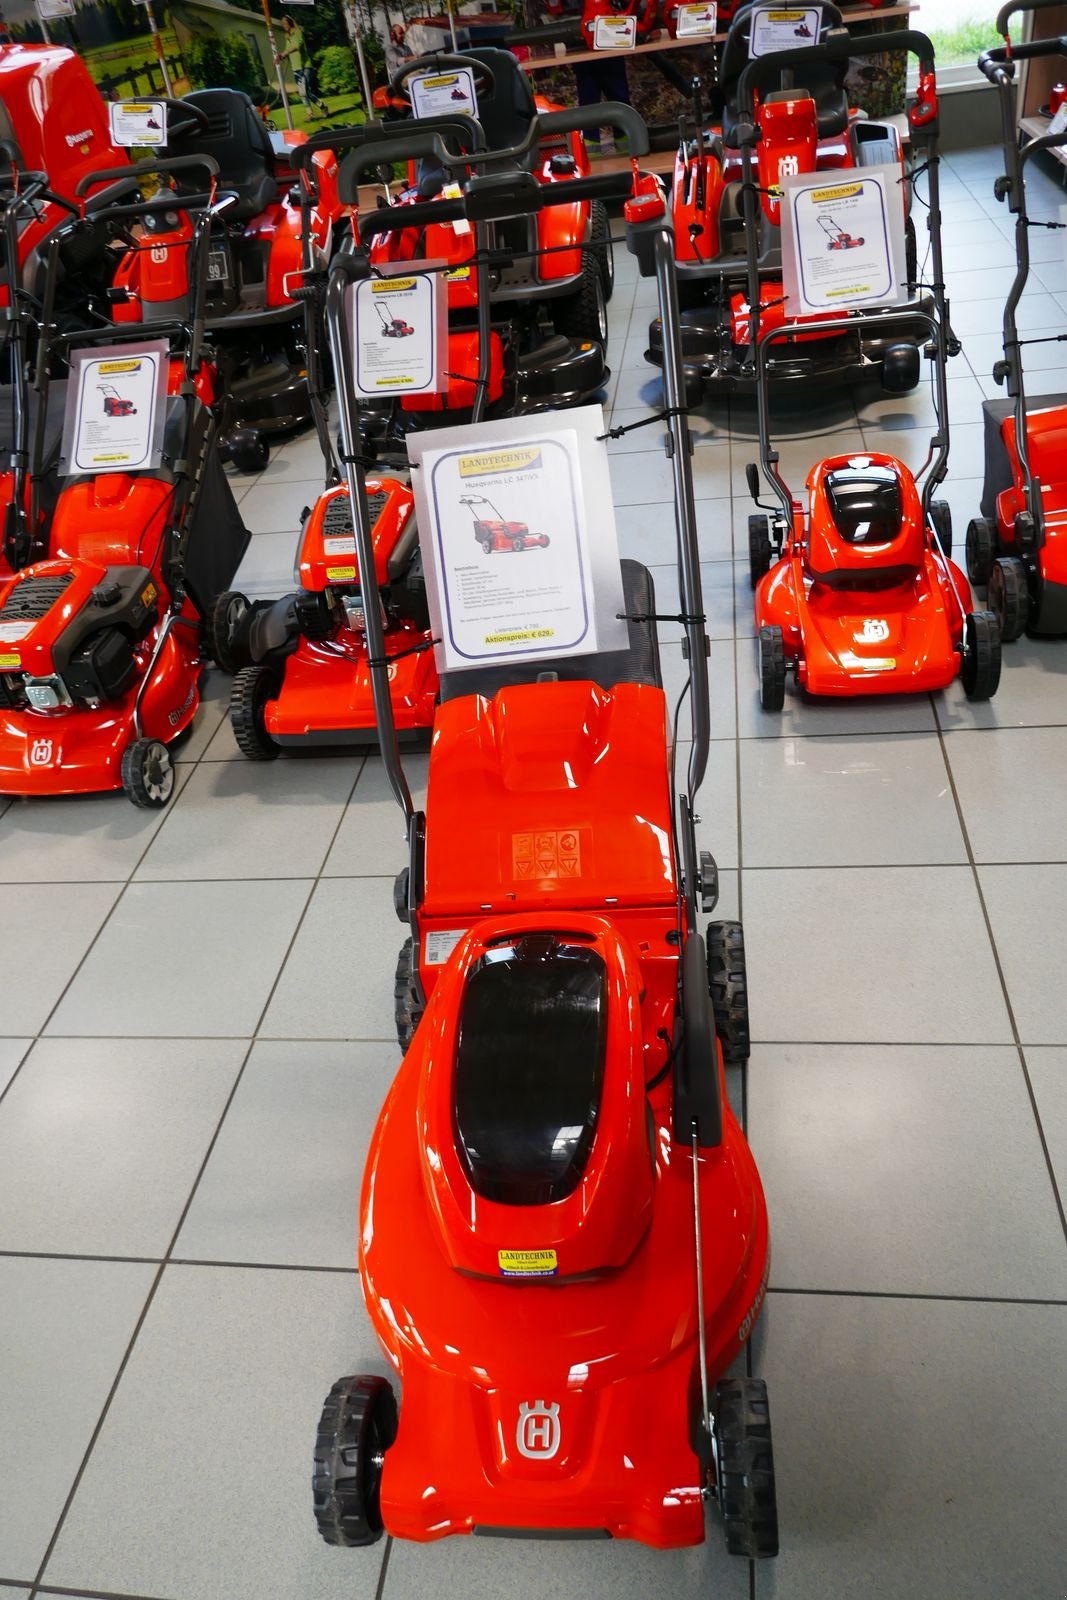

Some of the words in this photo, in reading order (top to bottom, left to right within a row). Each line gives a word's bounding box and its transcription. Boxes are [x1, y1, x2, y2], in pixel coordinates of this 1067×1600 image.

[812, 186, 857, 199] LANDTECHNIK
[372, 280, 413, 289] LANDTECHNIK
[461, 451, 533, 469] LANDTECHNIK
[465, 479, 504, 489] Husqvarna
[503, 477, 514, 485] LC
[485, 633, 531, 645] Aktionspreis:
[500, 1252, 554, 1260] LANDTECHNIK
